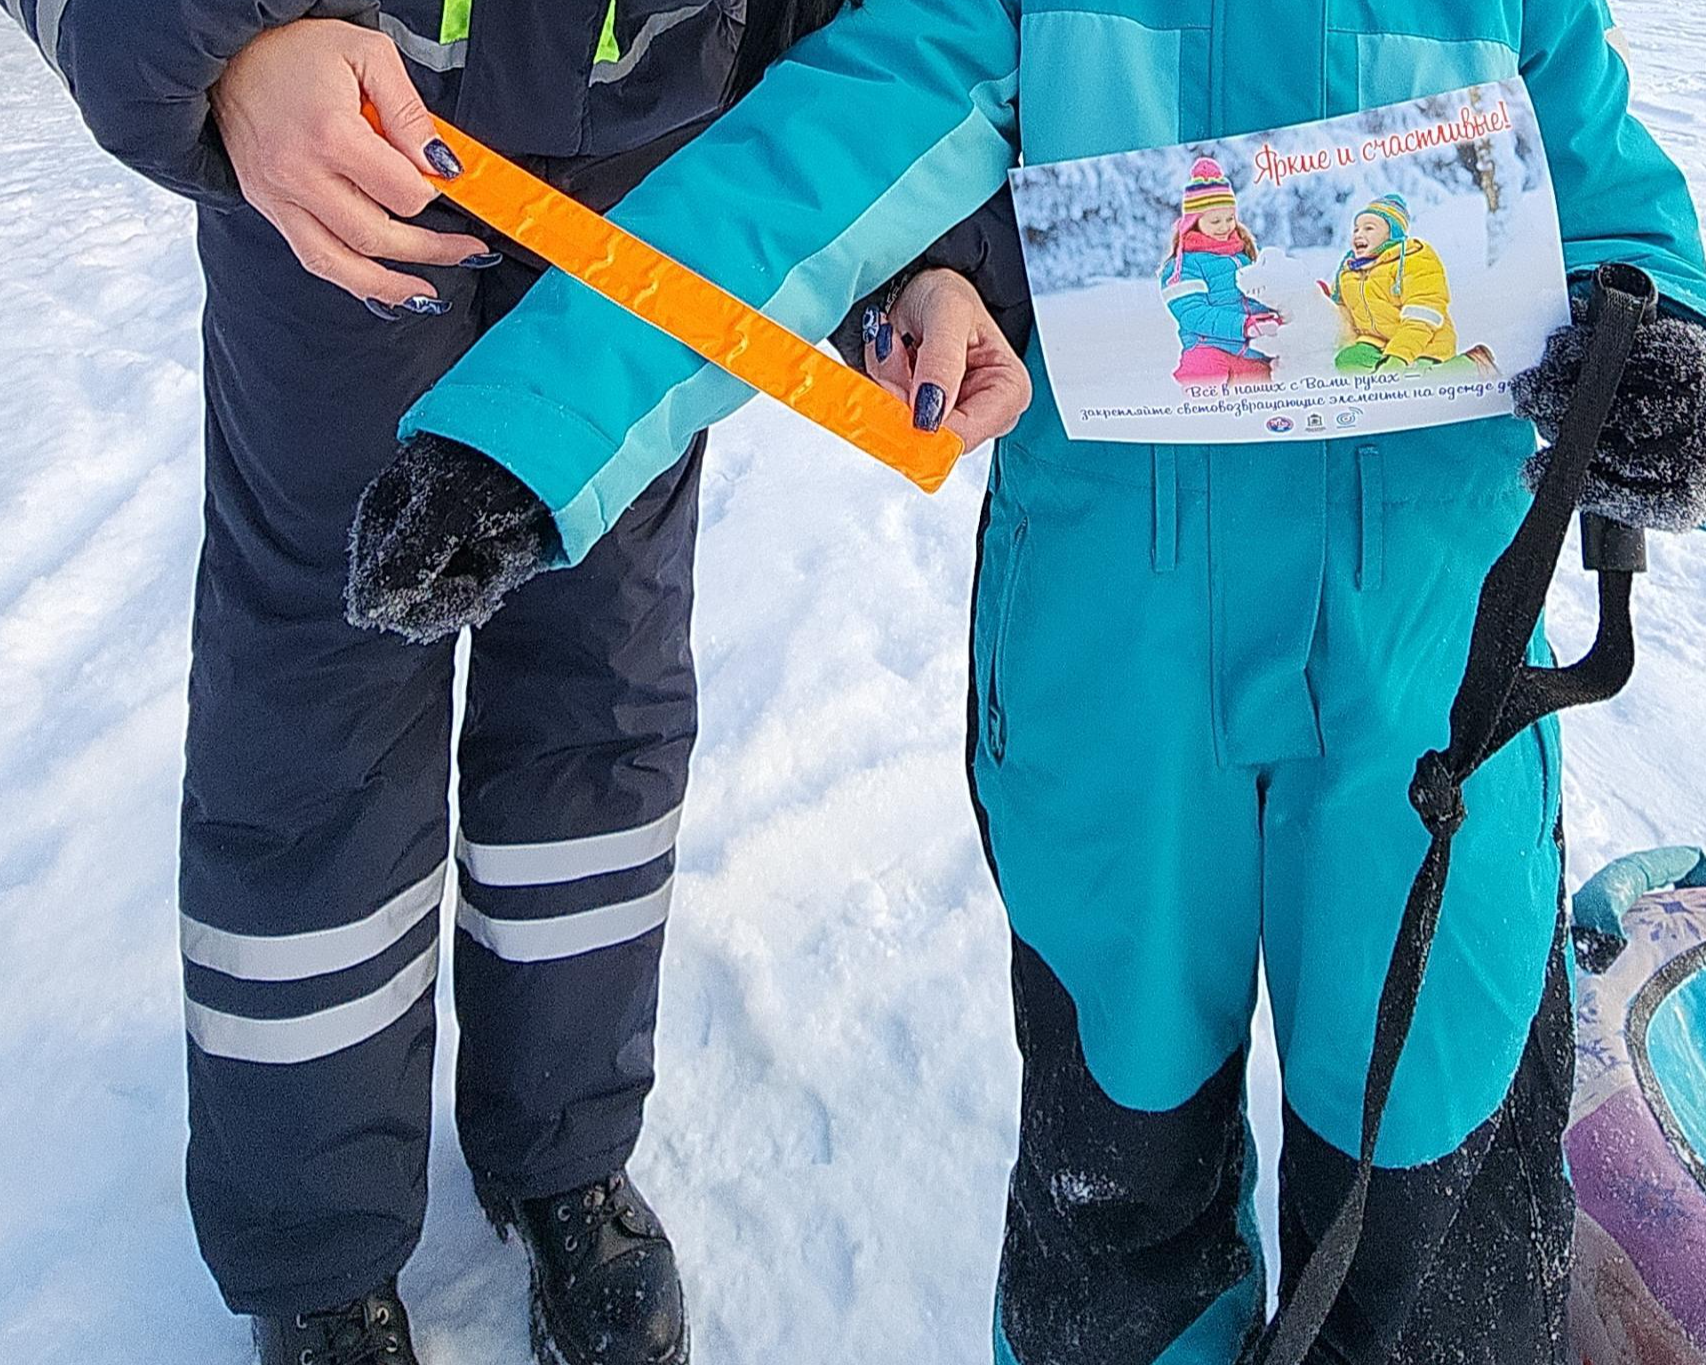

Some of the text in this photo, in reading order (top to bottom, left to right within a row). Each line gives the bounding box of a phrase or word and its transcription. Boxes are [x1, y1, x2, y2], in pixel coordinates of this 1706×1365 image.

[1253, 100, 1512, 186] Яркие и счастливые!
[1080, 404, 1174, 421] закрепляйте
[1176, 395, 1325, 416] световозвращающие
[1328, 390, 1410, 405] элементы
[1413, 388, 1434, 398] на
[1438, 382, 1494, 400] одежде
[1185, 384, 1218, 398] Всё
[1221, 383, 1230, 397] в
[1234, 381, 1286, 396] наших
[1290, 382, 1298, 391] с
[1300, 376, 1350, 390] Вами
[1353, 371, 1400, 391] руках
